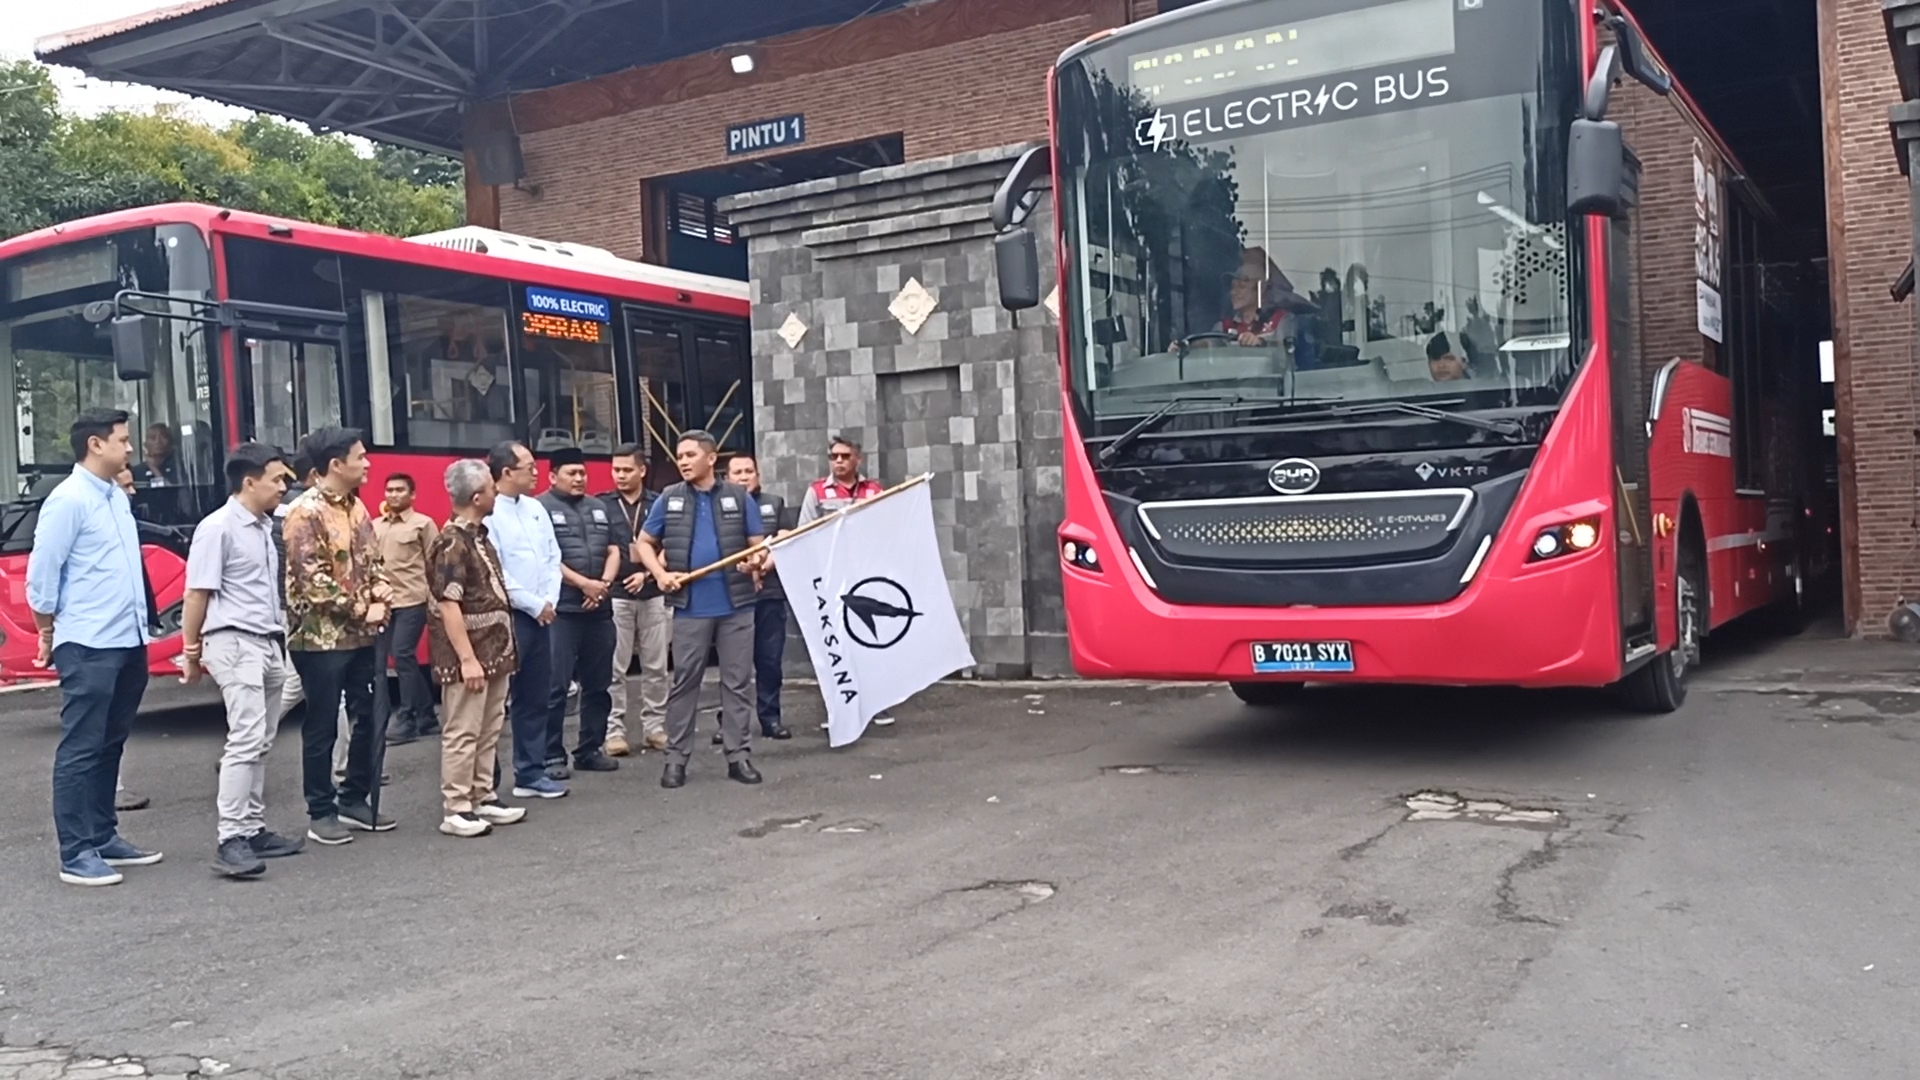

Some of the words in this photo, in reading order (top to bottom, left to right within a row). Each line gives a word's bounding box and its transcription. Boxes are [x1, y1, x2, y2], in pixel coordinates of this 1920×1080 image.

[1183, 81, 1358, 138] ELECTRIC
[1374, 66, 1450, 105] BUS
[730, 121, 786, 151] PINTU
[790, 117, 800, 139] 1
[531, 294, 559, 311] 100%
[560, 298, 606, 318] ELECTRIC
[522, 312, 599, 342] OPERASI
[1437, 465, 1489, 479] VKTR
[812, 576, 858, 705] LAKSANA
[1254, 644, 1266, 663] B
[1272, 643, 1313, 662] 7011
[1316, 643, 1348, 662] SYX
